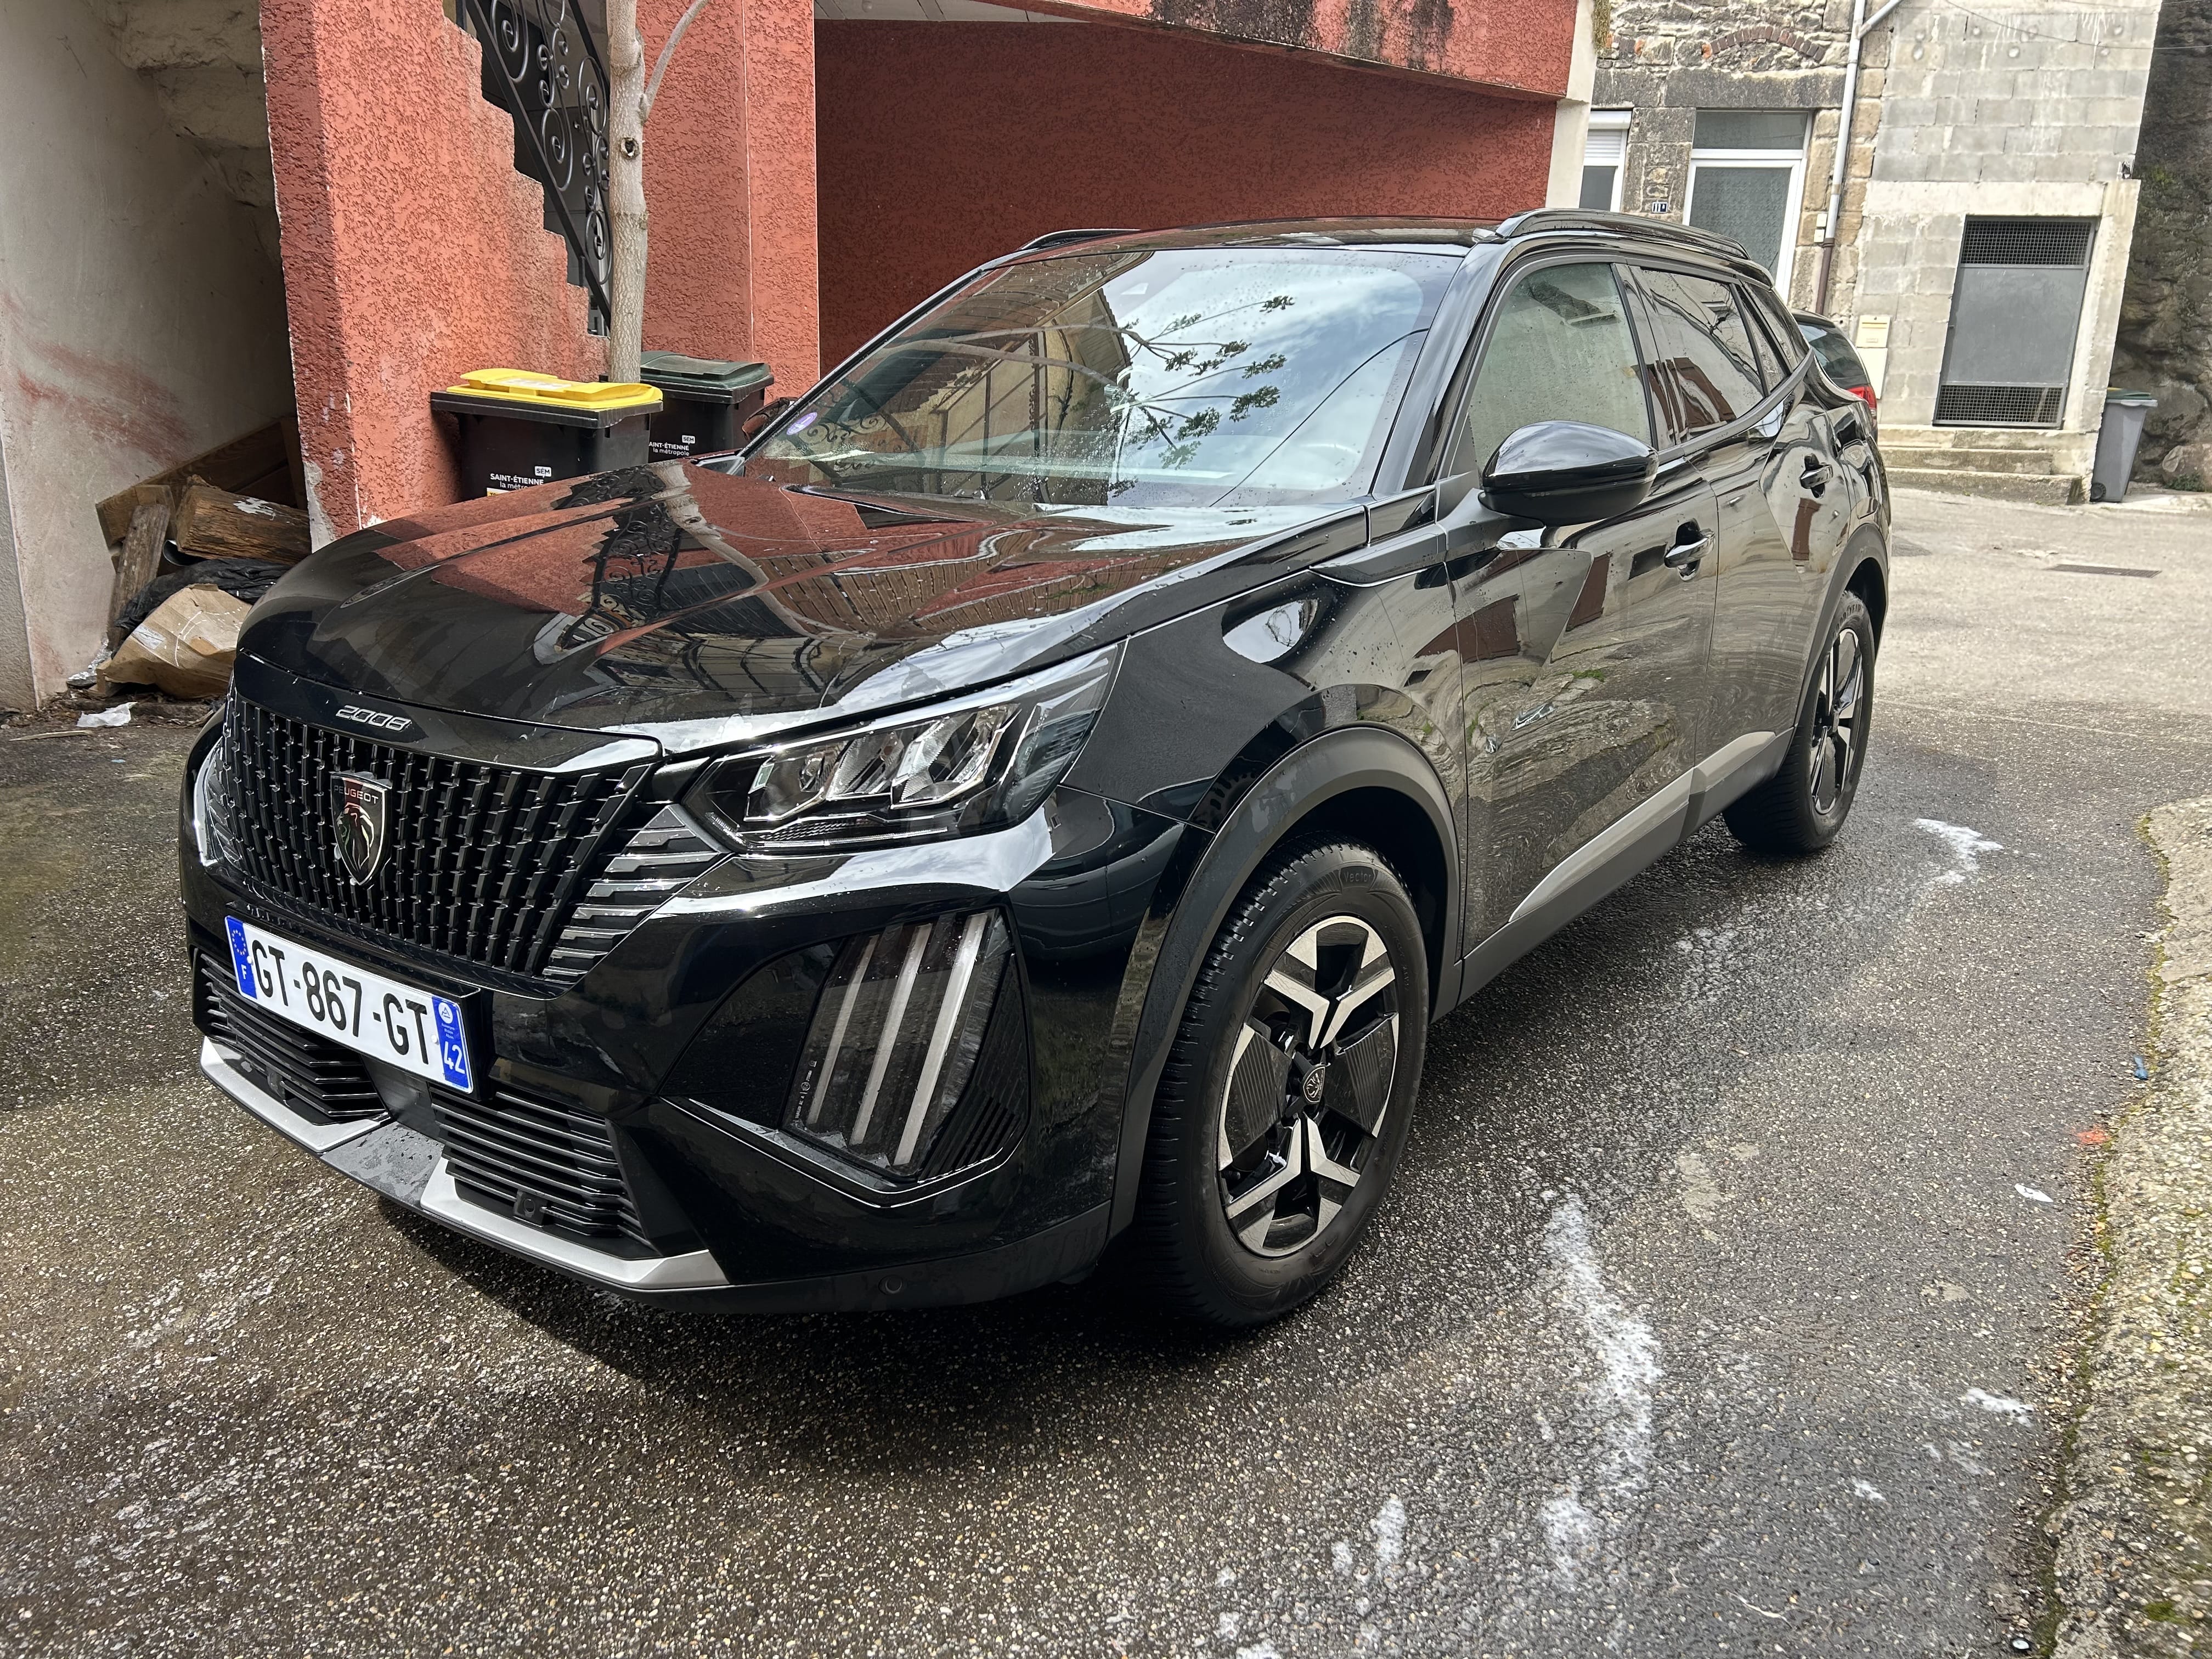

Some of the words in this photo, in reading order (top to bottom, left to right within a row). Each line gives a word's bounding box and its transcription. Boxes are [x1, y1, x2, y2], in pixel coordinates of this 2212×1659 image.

[648, 442, 689, 450] AINT-ÉTIENNE
[490, 473, 544, 486] SAINT-ÉTIENNE
[336, 705, 411, 732] 2008
[334, 785, 379, 805] PEUGEOT
[1344, 871, 1372, 882] Vector
[241, 964, 247, 980] F
[252, 939, 428, 1065] GT-867-GT
[444, 1041, 465, 1074] 42
